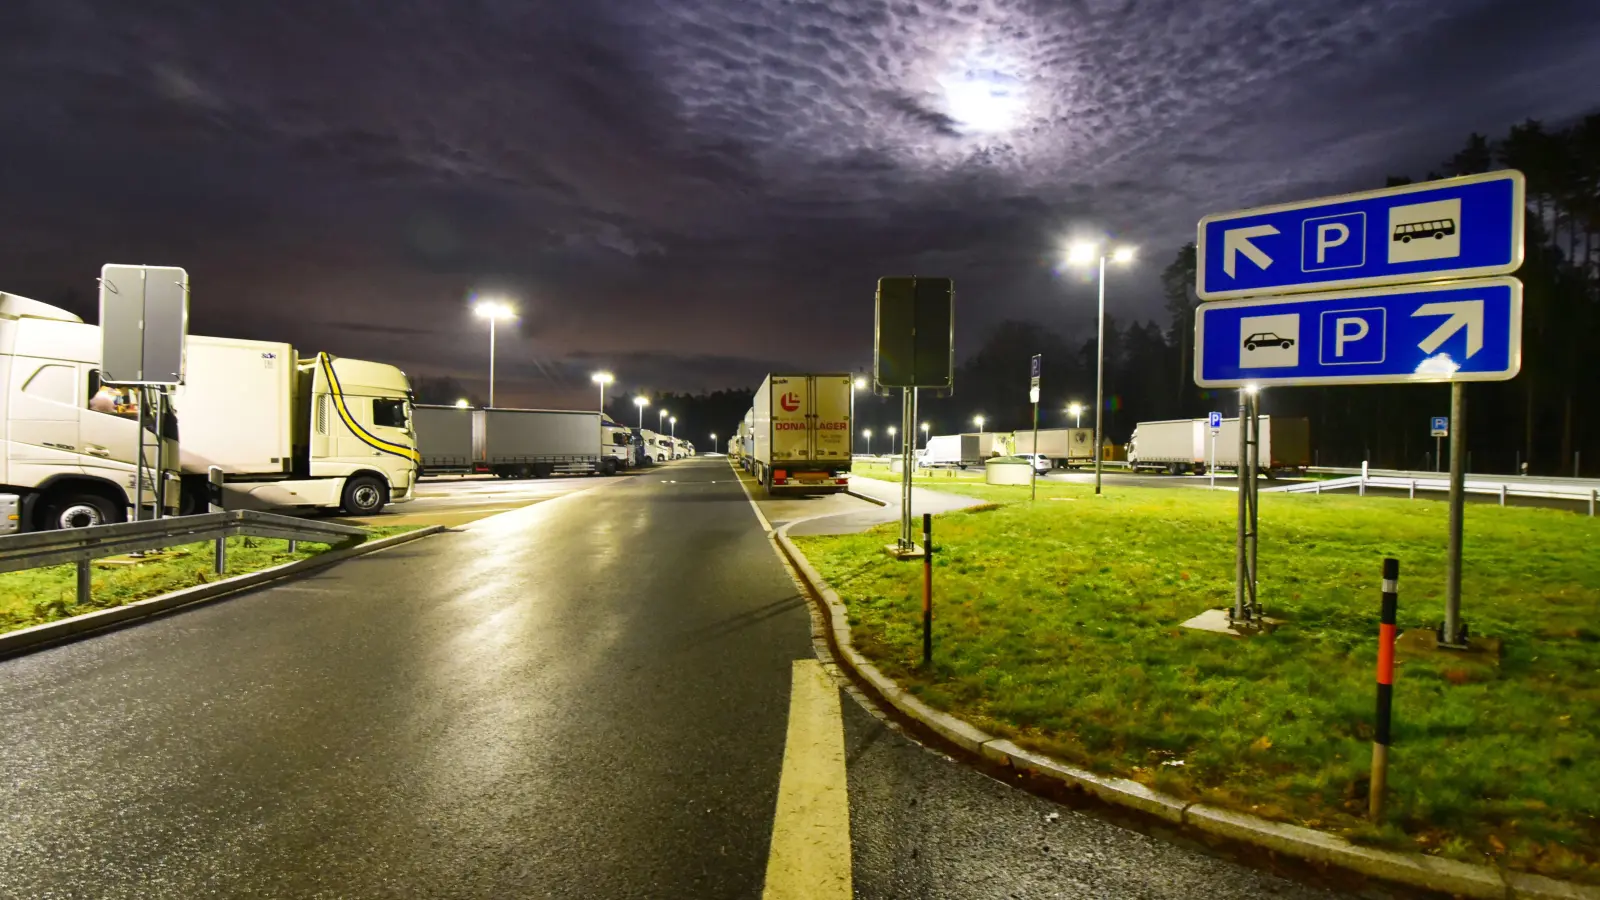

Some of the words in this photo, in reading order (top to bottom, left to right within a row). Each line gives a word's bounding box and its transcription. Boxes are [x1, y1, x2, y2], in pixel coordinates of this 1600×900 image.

[1316, 223, 1350, 264] P
[1335, 317, 1369, 357] P
[1212, 414, 1219, 426] P
[1435, 418, 1443, 429] P
